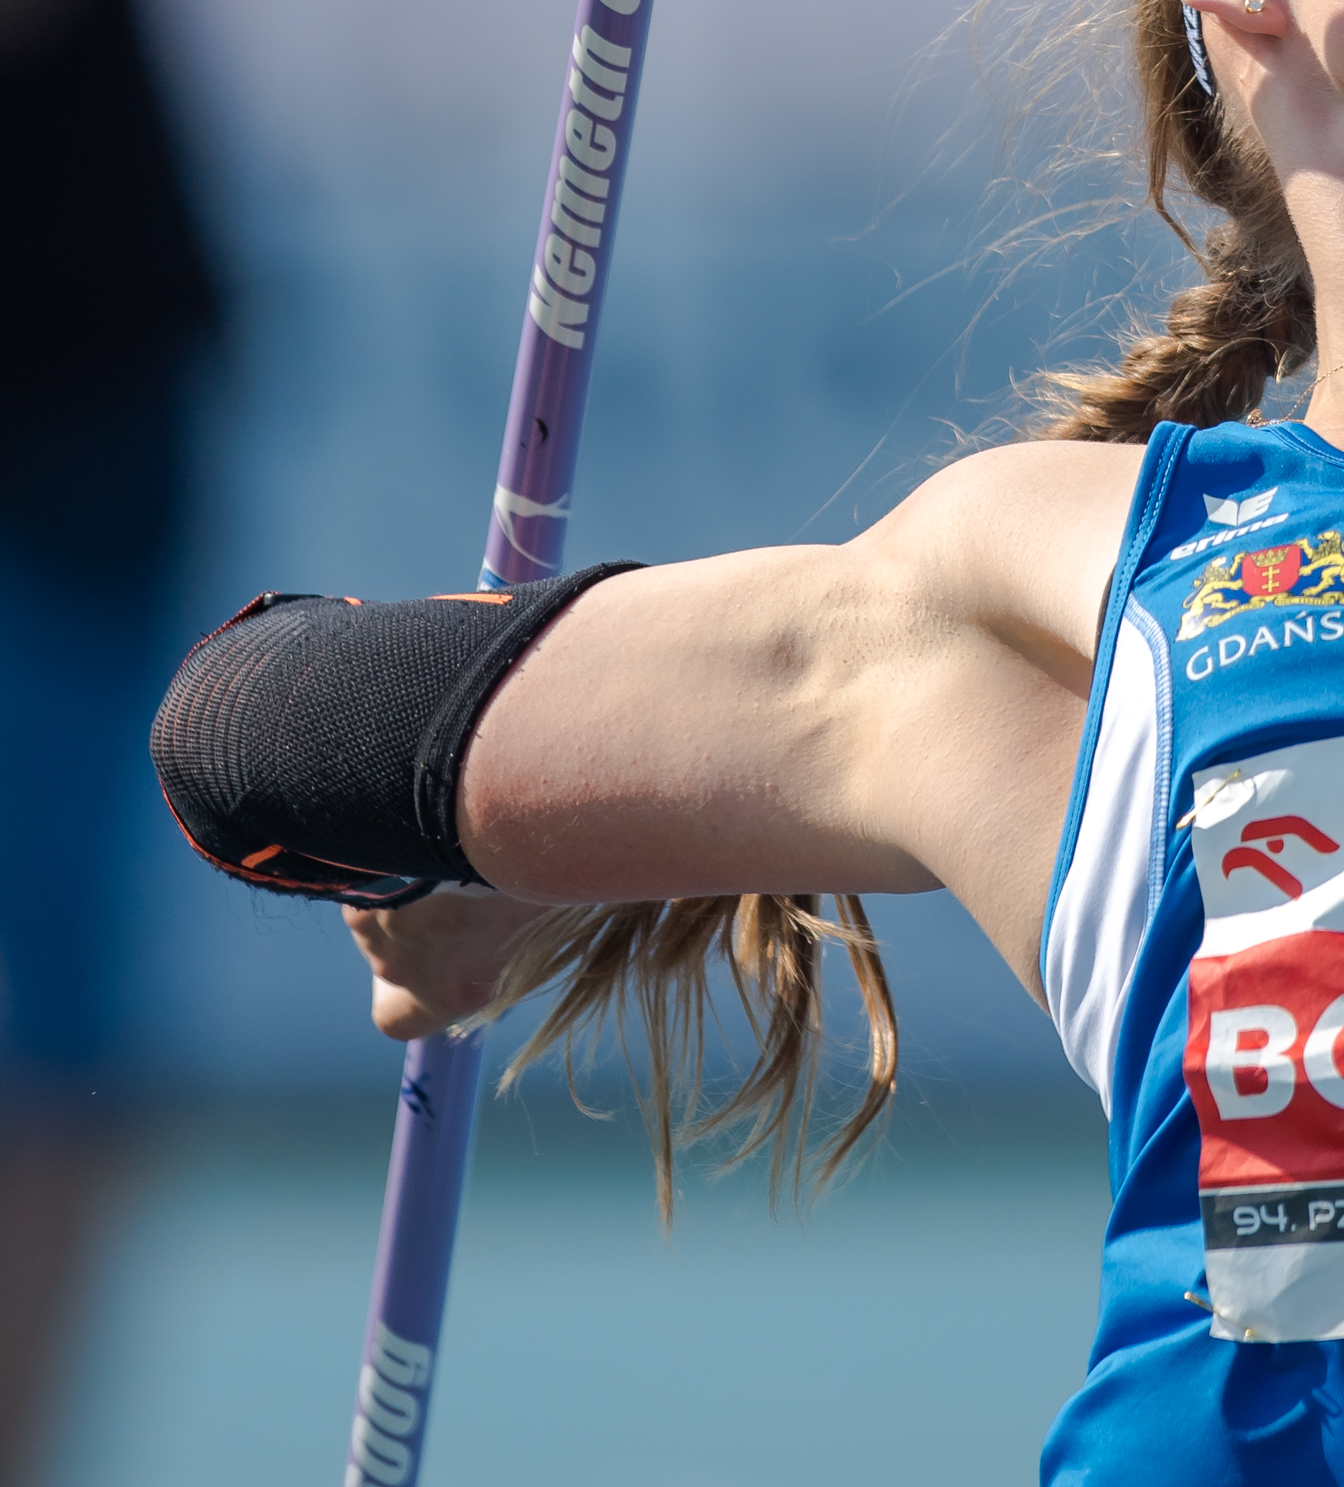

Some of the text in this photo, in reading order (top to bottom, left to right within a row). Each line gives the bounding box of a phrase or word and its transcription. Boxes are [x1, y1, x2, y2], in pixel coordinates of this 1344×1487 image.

[529, 24, 632, 350] Nemeth
[1170, 513, 1289, 560] erima
[1233, 1204, 1296, 1235] 94.
